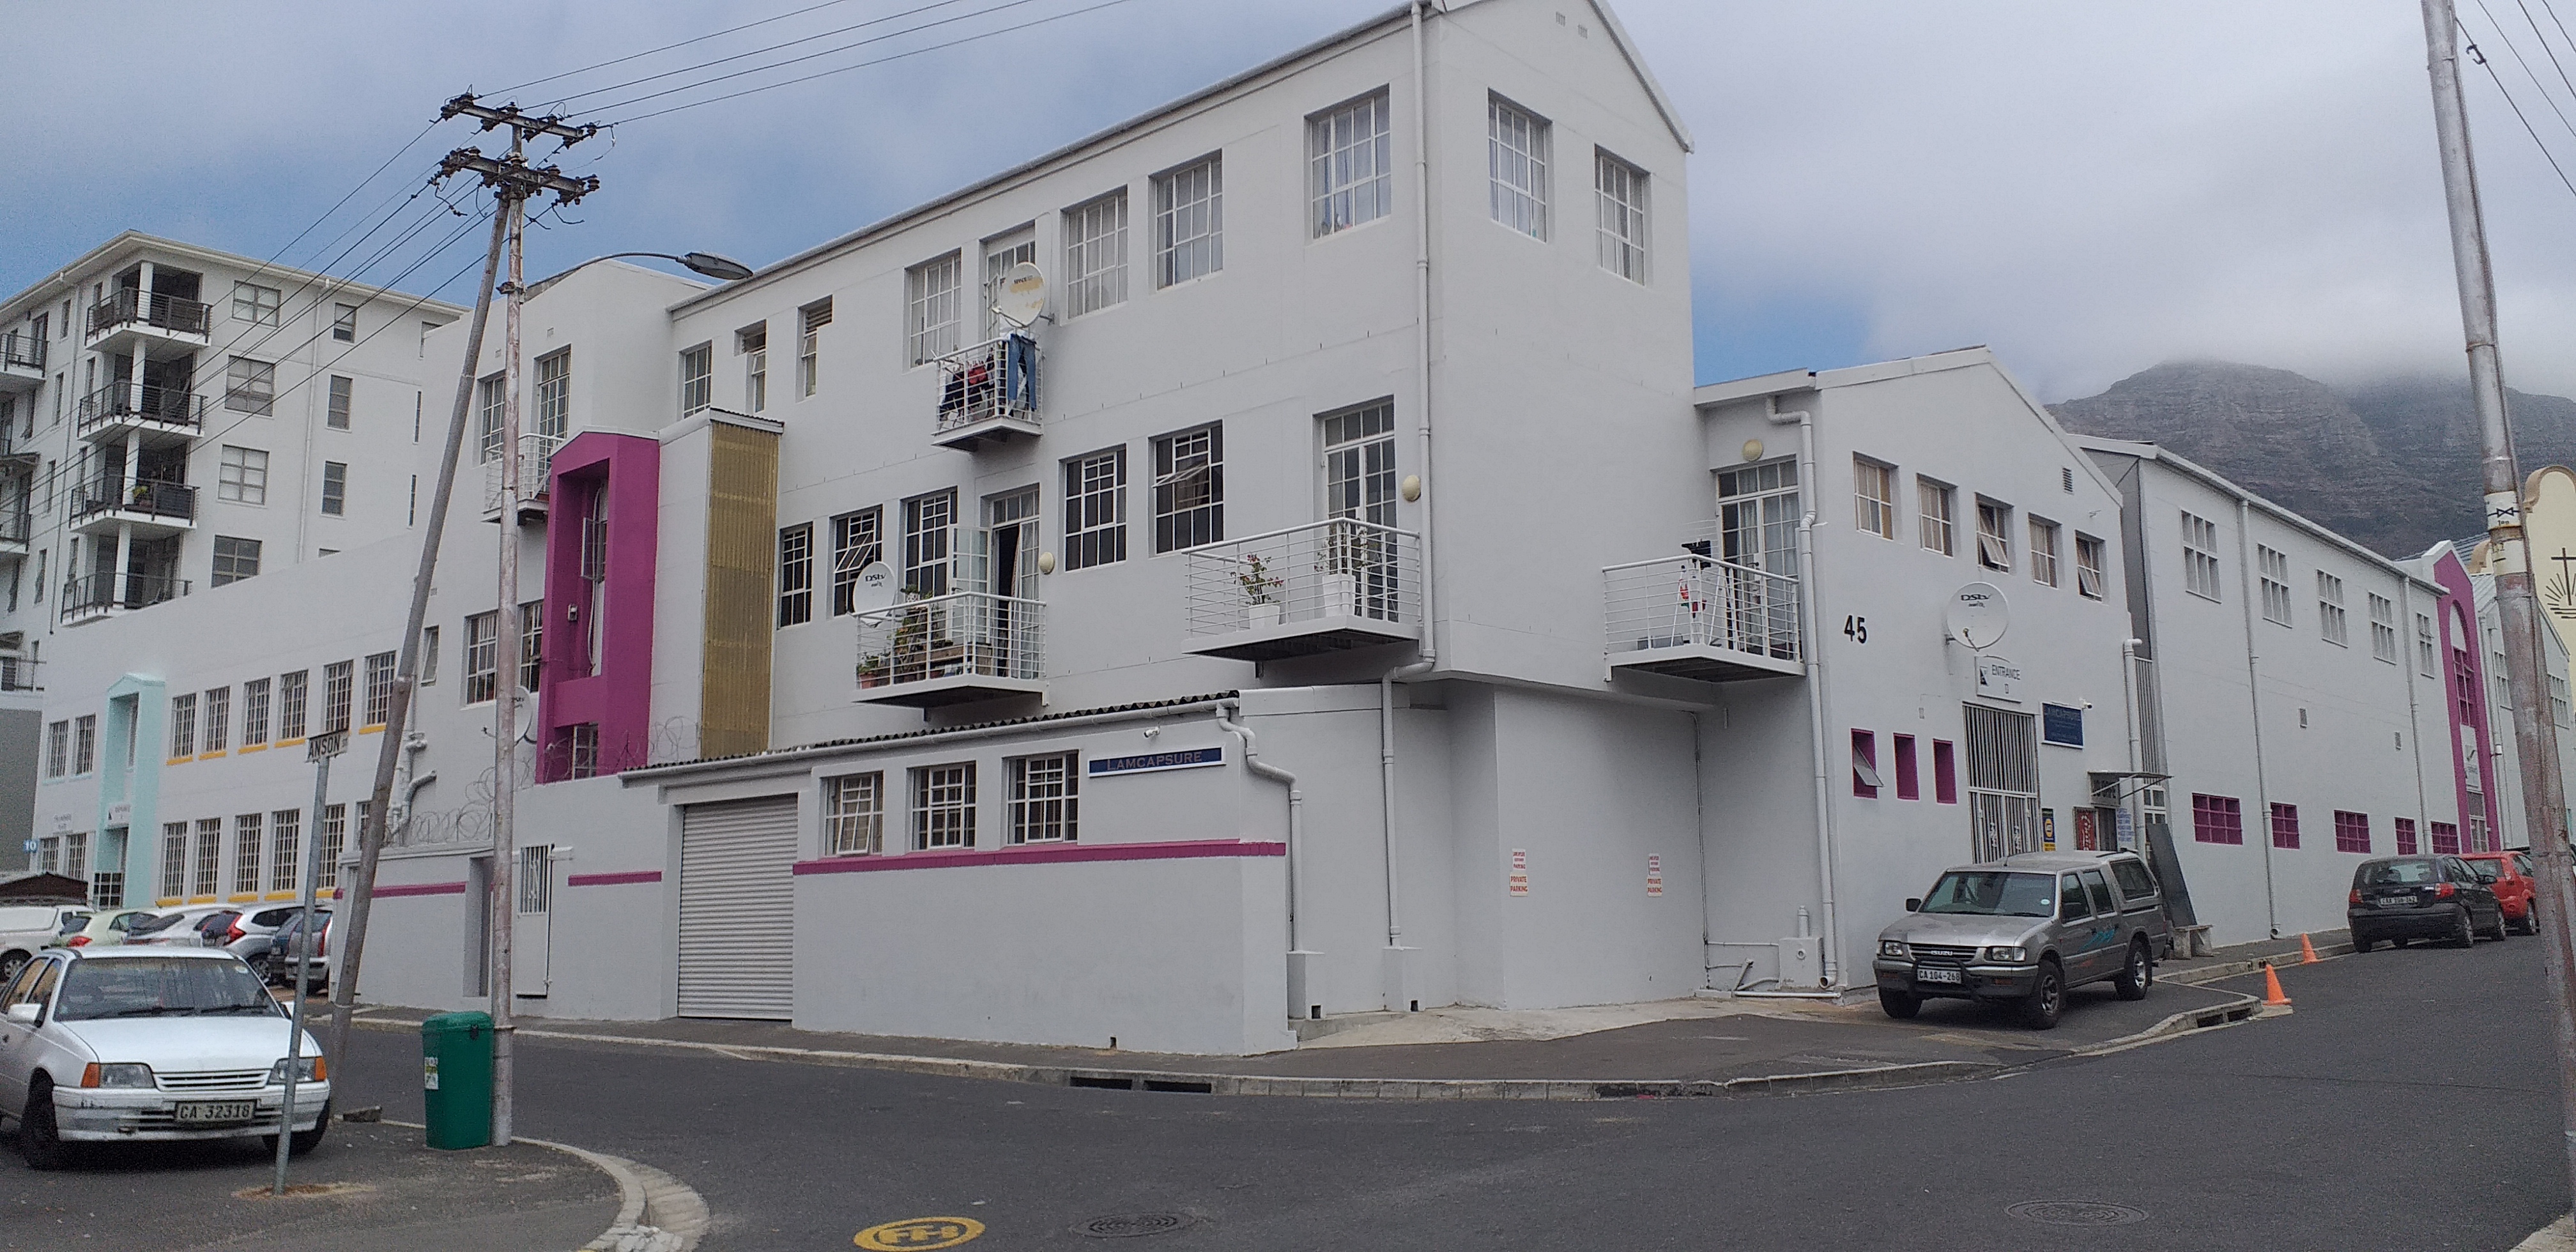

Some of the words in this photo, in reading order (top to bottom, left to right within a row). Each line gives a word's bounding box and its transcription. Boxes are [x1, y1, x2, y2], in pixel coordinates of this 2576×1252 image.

[1844, 615, 1867, 643] 45
[1992, 664, 2020, 680] ENTRANCE
[308, 733, 340, 758] ANSON
[24, 841, 37, 851] 10
[1919, 970, 1928, 979] CA
[181, 1104, 197, 1119] CA
